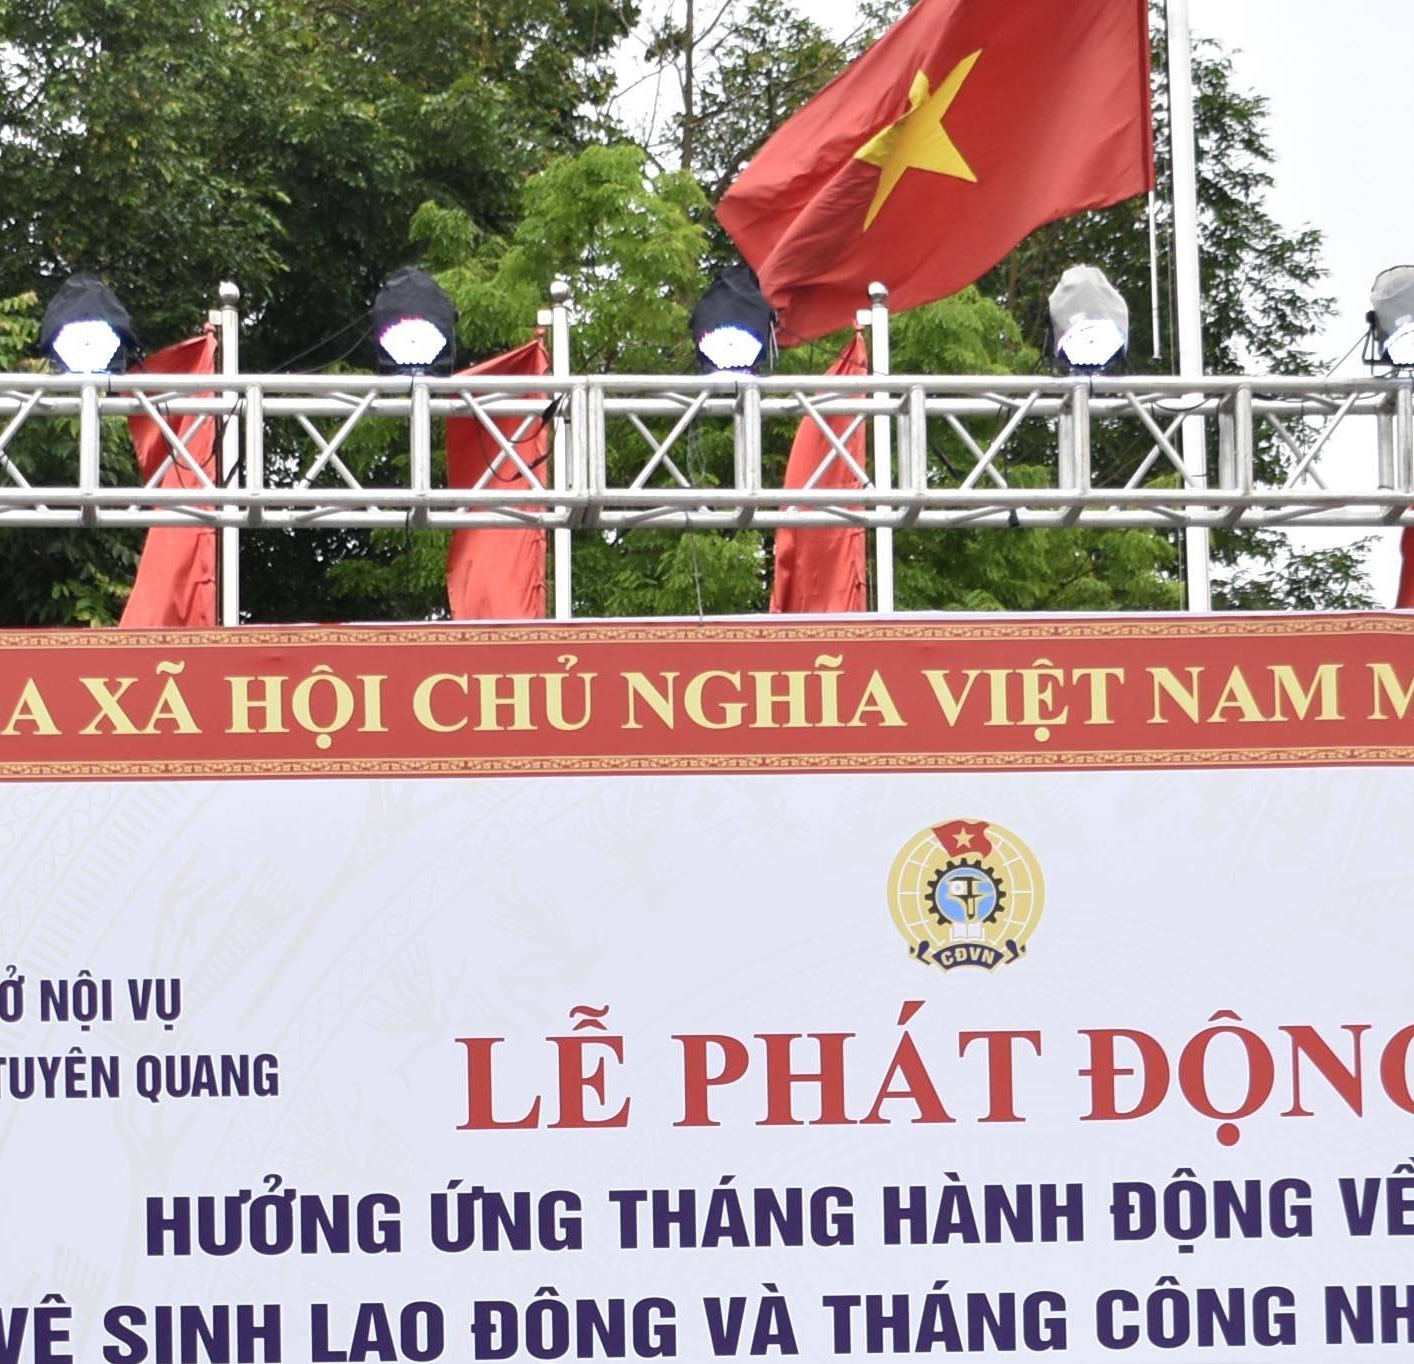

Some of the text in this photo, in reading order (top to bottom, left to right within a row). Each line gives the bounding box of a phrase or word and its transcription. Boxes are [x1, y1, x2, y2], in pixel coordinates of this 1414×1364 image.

[79, 660, 204, 736] XÃ
[224, 664, 388, 750] HỘI
[413, 654, 598, 733] CHỦ
[620, 654, 908, 729] NGHĨA
[921, 658, 1125, 742] VIỆT
[1146, 664, 1345, 724] NAM
[40, 968, 113, 1032] NỘI
[127, 978, 181, 1031] VỤ
[136, 1053, 279, 1104] QUANG
[458, 1003, 633, 1131] LỄ
[672, 999, 1044, 1128] PHÁT
[146, 1174, 401, 1257] HƯỞNG
[430, 1179, 582, 1253] ỨNG
[608, 1175, 854, 1249] THÁNG
[882, 1171, 1084, 1245] HÀNH
[1109, 1167, 1313, 1254] ĐỘNG
[310, 1300, 445, 1363] LAO
[702, 1282, 799, 1357] VÀ
[822, 1279, 1067, 1355] THÁNG
[1096, 1275, 1297, 1350] CÔNG
